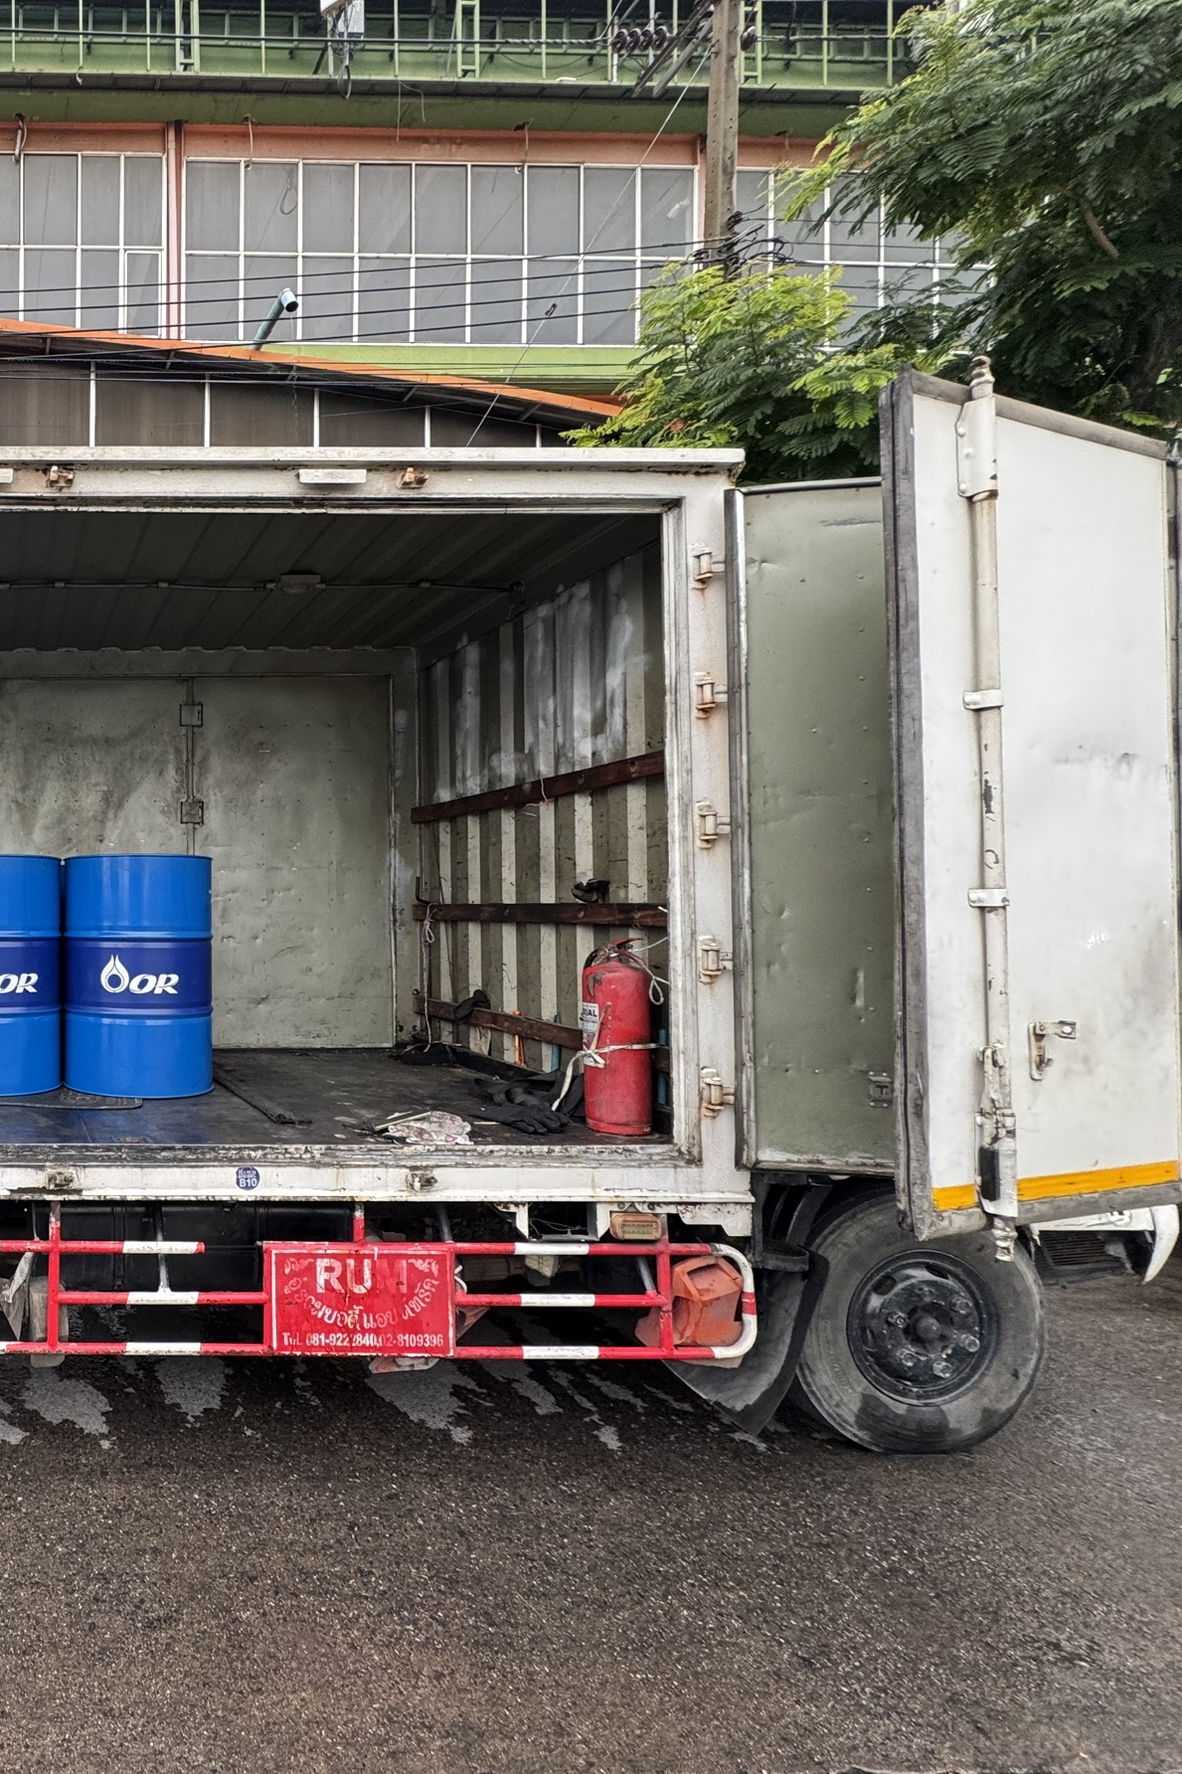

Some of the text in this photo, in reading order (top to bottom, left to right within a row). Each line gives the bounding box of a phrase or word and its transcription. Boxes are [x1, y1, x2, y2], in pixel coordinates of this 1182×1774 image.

[129, 973, 179, 994] OR
[239, 1178, 257, 1187] B10
[316, 1258, 408, 1294] RUM
